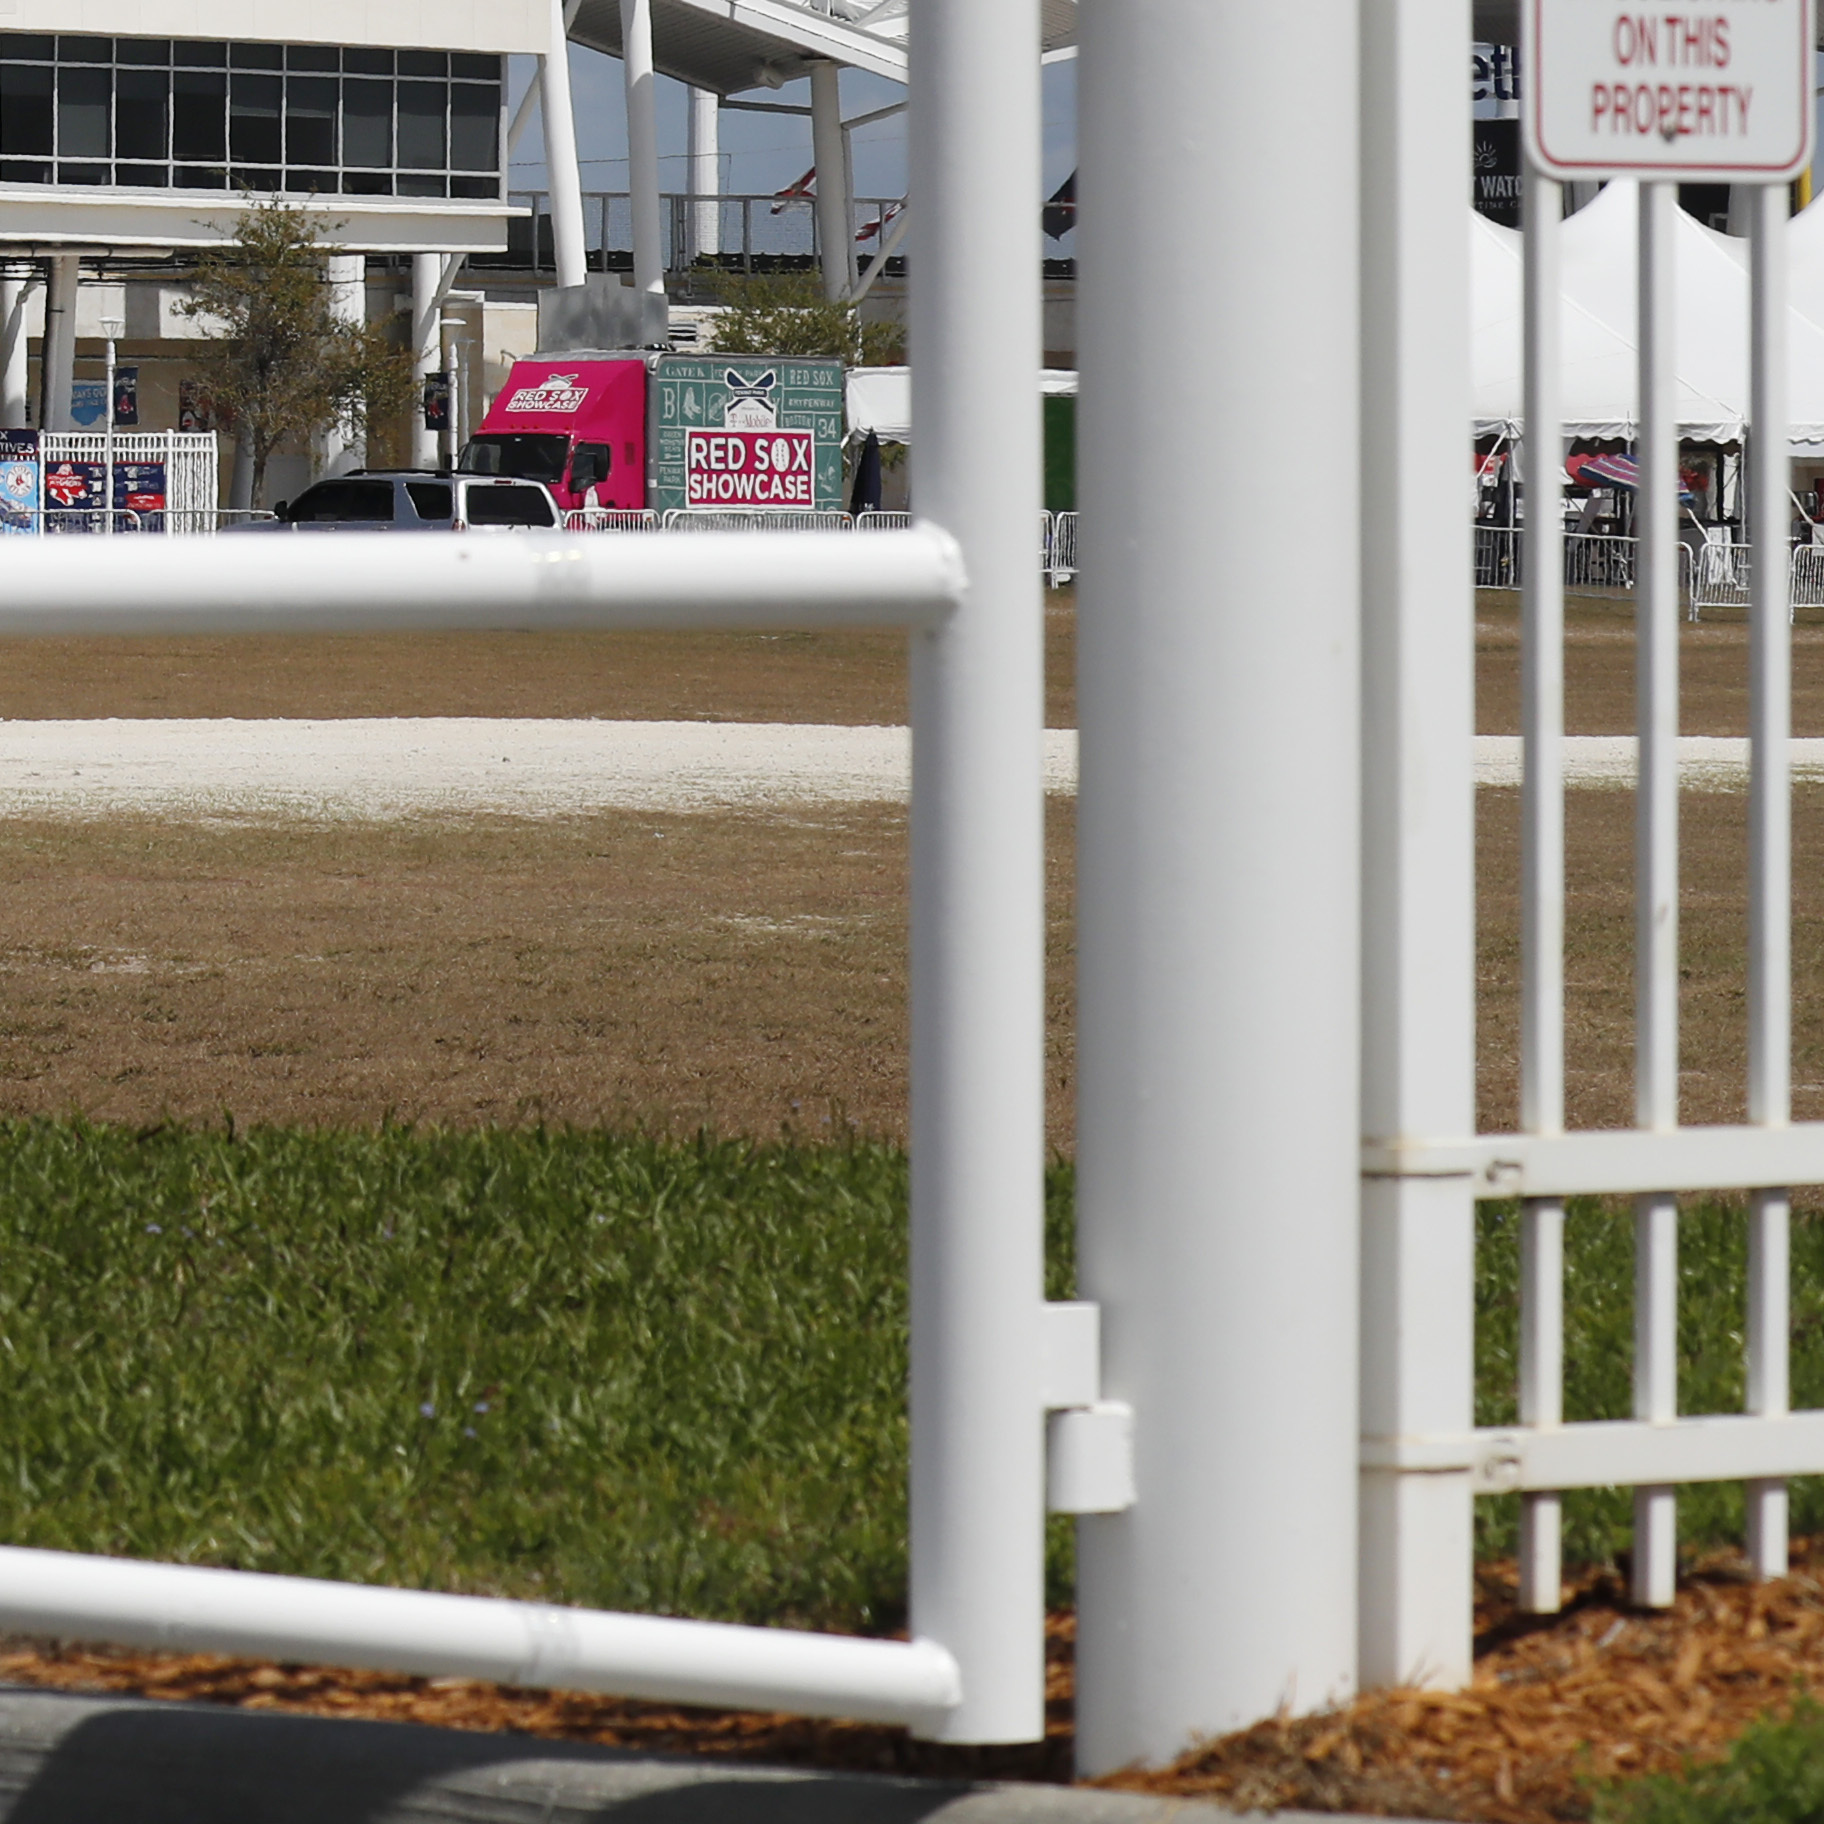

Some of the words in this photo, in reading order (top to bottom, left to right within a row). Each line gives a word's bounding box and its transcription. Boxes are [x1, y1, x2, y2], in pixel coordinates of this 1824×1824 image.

[1613, 15, 1657, 69] ON
[1664, 16, 1731, 69] THIS
[1591, 83, 1754, 137] PROPERTY
[790, 369, 810, 385] RED
[813, 370, 834, 386] SOX
[508, 401, 578, 410] SHOWCASE
[515, 390, 547, 401] RED
[549, 390, 583, 401] SOX
[817, 417, 837, 439] 34
[690, 437, 747, 471] RED
[753, 437, 809, 472] SOX
[689, 473, 810, 501] SHOWCASE
